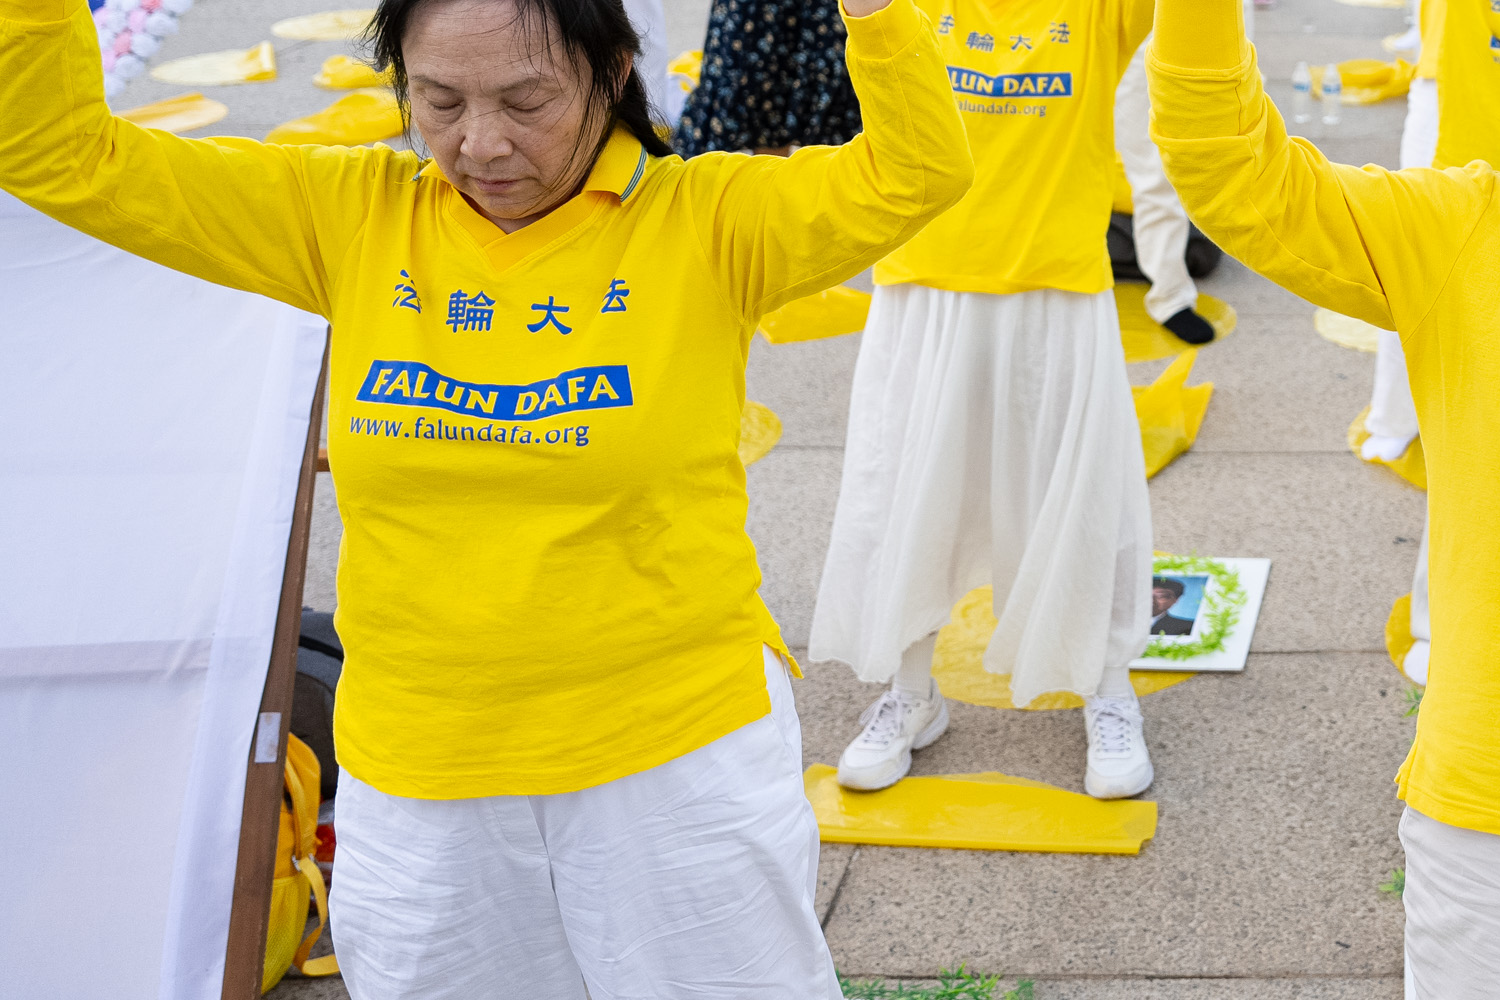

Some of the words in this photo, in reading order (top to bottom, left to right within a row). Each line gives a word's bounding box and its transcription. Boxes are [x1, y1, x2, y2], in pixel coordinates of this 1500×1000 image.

[951, 70, 994, 94] LUN
[1003, 76, 1066, 94] DAFA
[956, 98, 1047, 118] alundafa.org
[371, 368, 499, 414] FALUN
[514, 374, 619, 416] DAFA
[350, 417, 590, 447] www.falundafa.org
